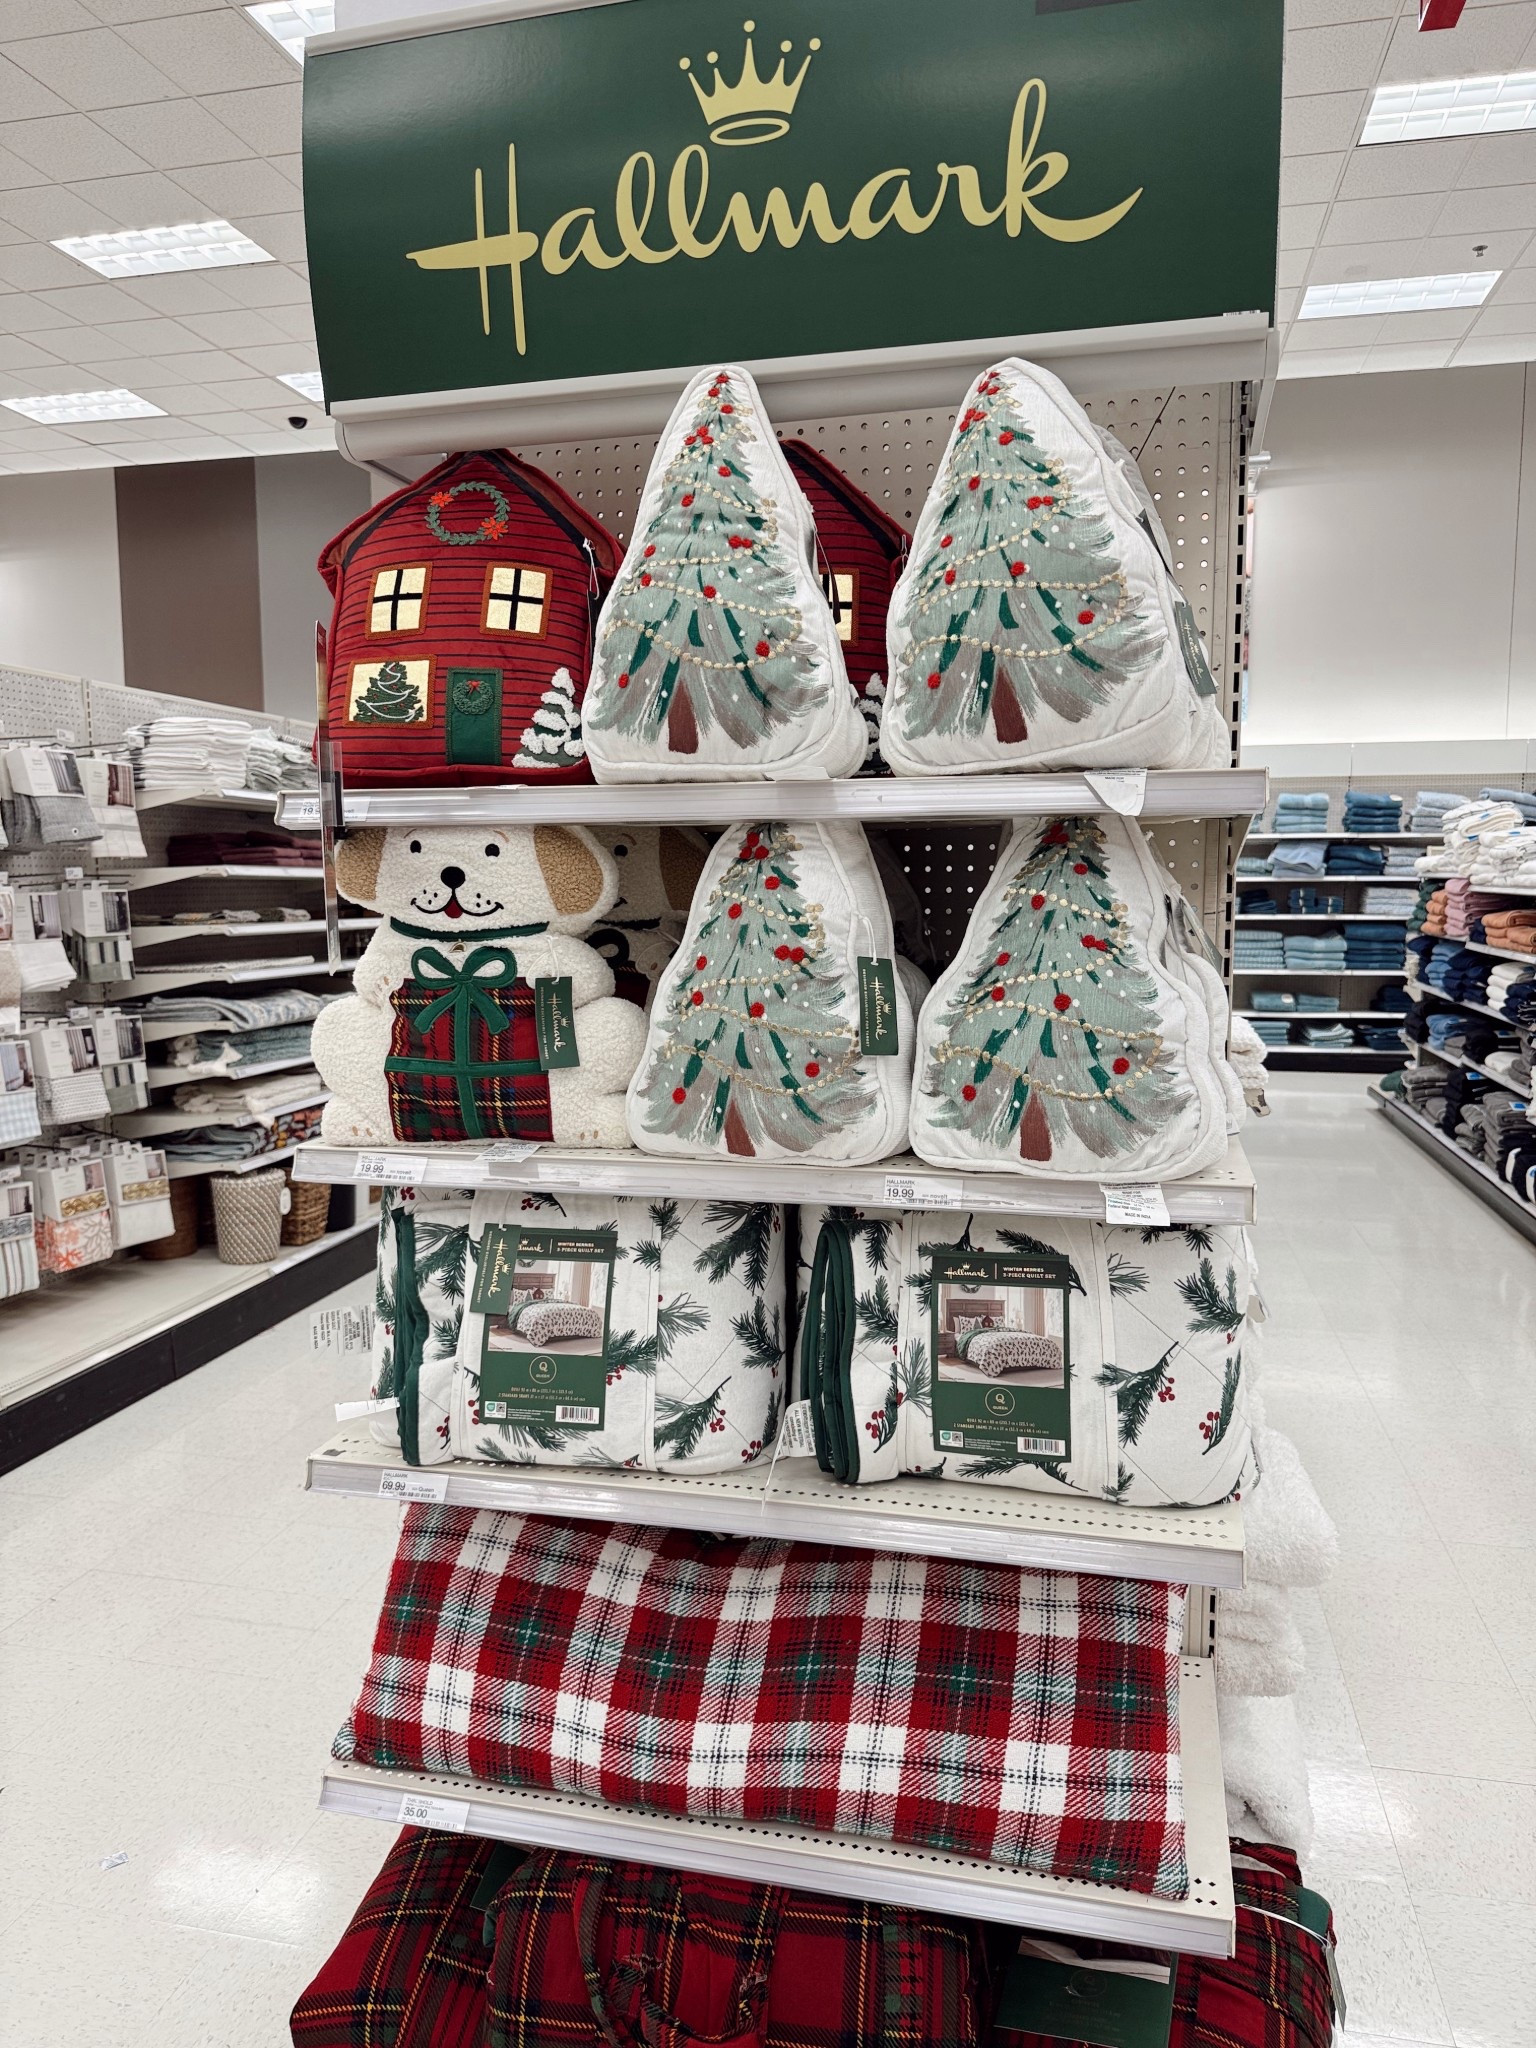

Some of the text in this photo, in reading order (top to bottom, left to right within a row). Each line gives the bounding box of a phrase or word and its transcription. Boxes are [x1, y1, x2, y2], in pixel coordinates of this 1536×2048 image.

[405, 77, 1144, 356] Hallmark
[1184, 619, 1203, 678] Hallmark
[869, 976, 888, 1041] Hallmark
[546, 992, 566, 1053] Hallmark
[360, 1163, 384, 1174] 19.99
[886, 1187, 914, 1198] 19.99
[518, 1243, 544, 1253] lmark
[487, 1237, 509, 1298] Hallmark
[944, 1266, 989, 1280] Hallmark
[539, 1361, 548, 1372] Q
[995, 1393, 1006, 1404] Q
[382, 1480, 406, 1491] 69.99
[403, 1806, 428, 1819] 35.00
